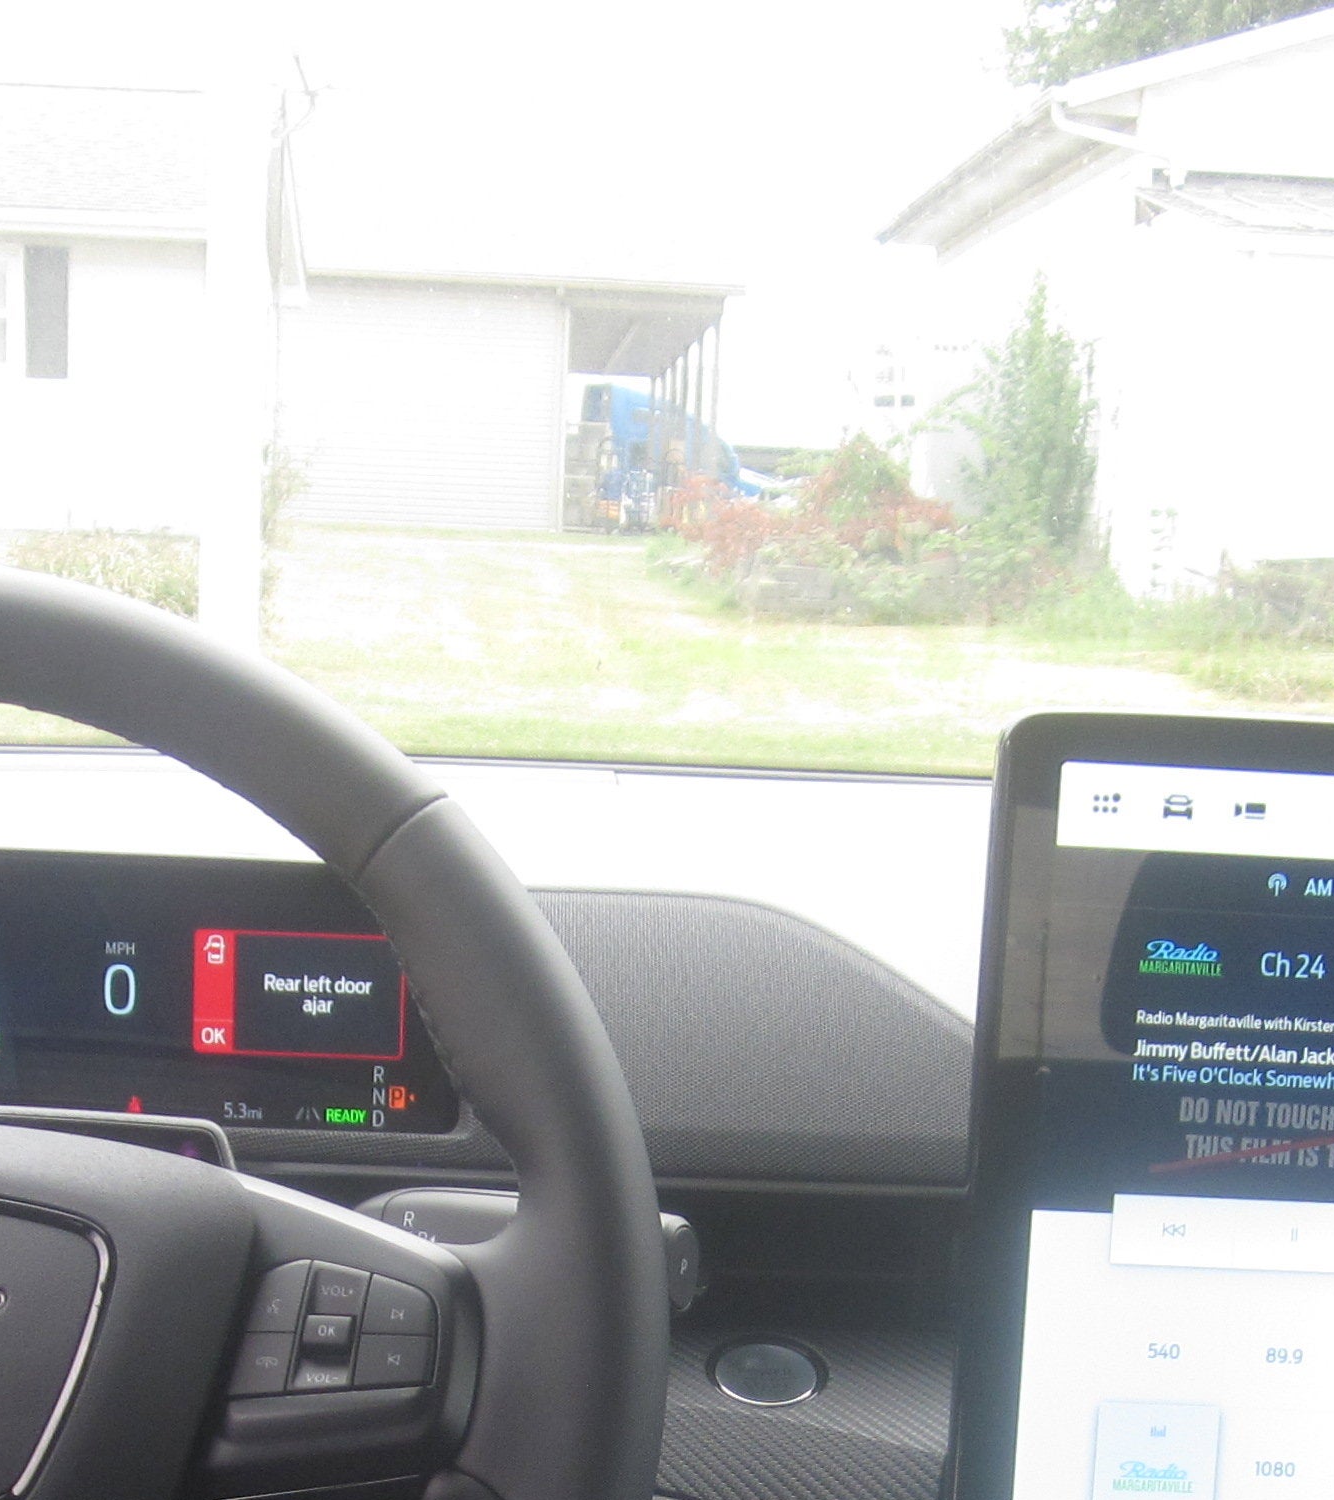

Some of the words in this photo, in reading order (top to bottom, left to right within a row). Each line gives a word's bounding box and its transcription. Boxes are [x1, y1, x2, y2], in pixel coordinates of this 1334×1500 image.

[1304, 877, 1334, 897] AM
[105, 941, 136, 955] MPH
[1146, 939, 1220, 961] Radio
[1138, 958, 1223, 977] MARGARITAVILLE
[1260, 951, 1290, 977] Ch
[1294, 953, 1326, 979] 24
[104, 963, 136, 1015] 0
[263, 973, 302, 991] Rear
[303, 975, 332, 993] left
[333, 976, 373, 995] door
[302, 997, 334, 1016] ajar
[1135, 1009, 1173, 1025] Radio
[1175, 1012, 1262, 1030] Margaritaville
[1264, 1016, 1292, 1031] with
[200, 1027, 226, 1045] OK
[1133, 1039, 1188, 1061] Jimmy
[1190, 1041, 1298, 1063] Buffett/Alan
[373, 1066, 385, 1083] R
[1132, 1064, 1159, 1081] It's
[1162, 1065, 1197, 1083] Five
[1199, 1066, 1262, 1086] O'Clock
[372, 1087, 385, 1105] N
[391, 1088, 404, 1107] P
[325, 1108, 367, 1124] READY
[372, 1109, 385, 1127] D
[1179, 1096, 1210, 1123] DO
[1216, 1098, 1261, 1126] NOT
[1185, 1133, 1234, 1160] THIS
[1240, 1137, 1292, 1165] FILM
[1297, 1141, 1318, 1168] IS
[403, 1210, 415, 1227] R
[318, 1324, 336, 1337] OK
[1147, 1342, 1181, 1360] 540
[1265, 1348, 1304, 1365] 89.9
[1119, 1460, 1188, 1479] Radio
[1255, 1460, 1296, 1478] 1080
[1112, 1479, 1193, 1494] MARGARITAVILLE
